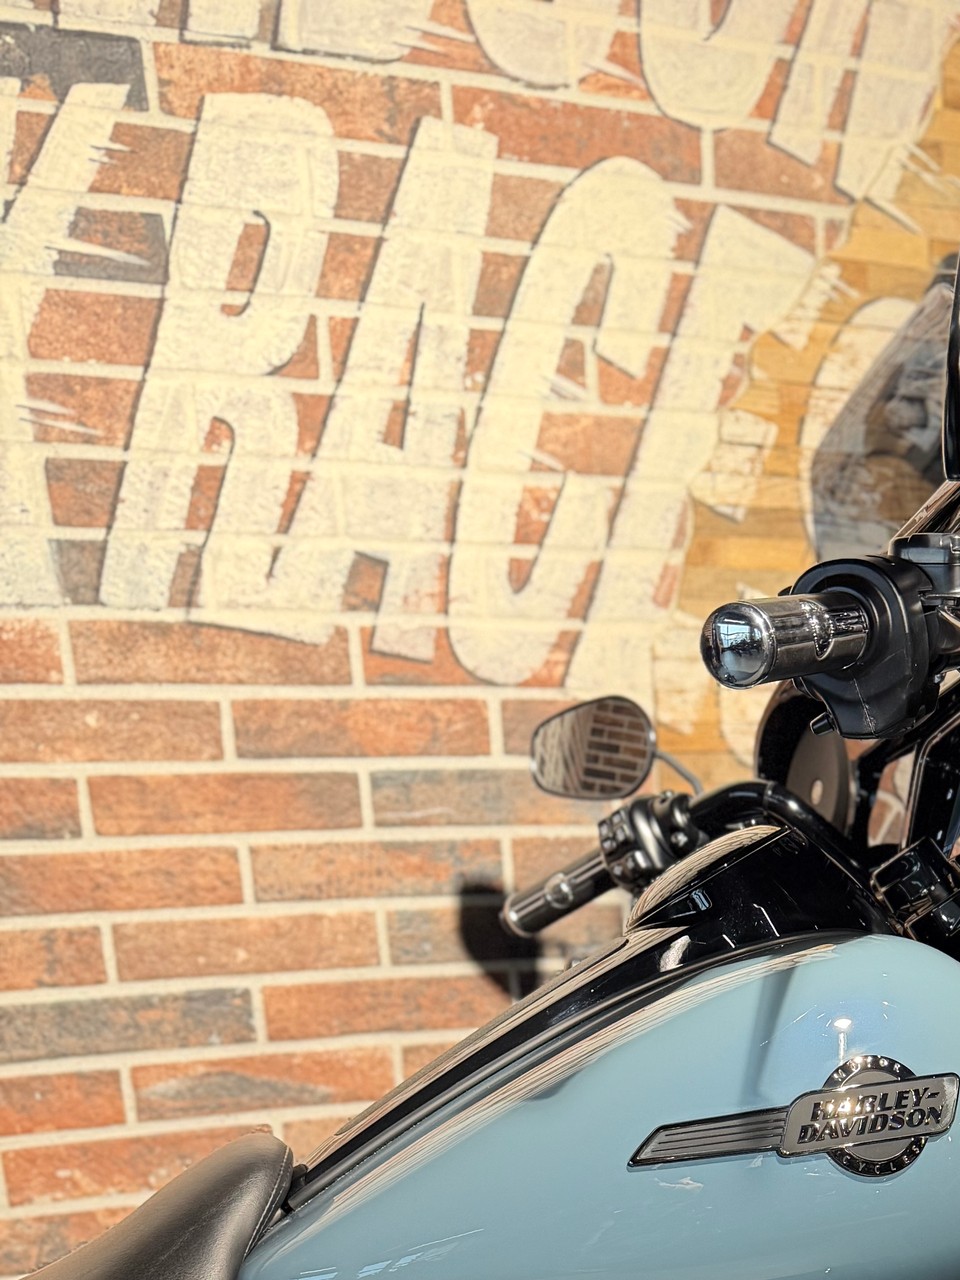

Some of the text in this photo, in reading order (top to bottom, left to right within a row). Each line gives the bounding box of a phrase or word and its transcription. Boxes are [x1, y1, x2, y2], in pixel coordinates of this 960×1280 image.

[833, 1057, 901, 1082] MOTOR
[797, 1105, 944, 1145] DAVIDSON
[842, 1145, 921, 1175] CYCLES
